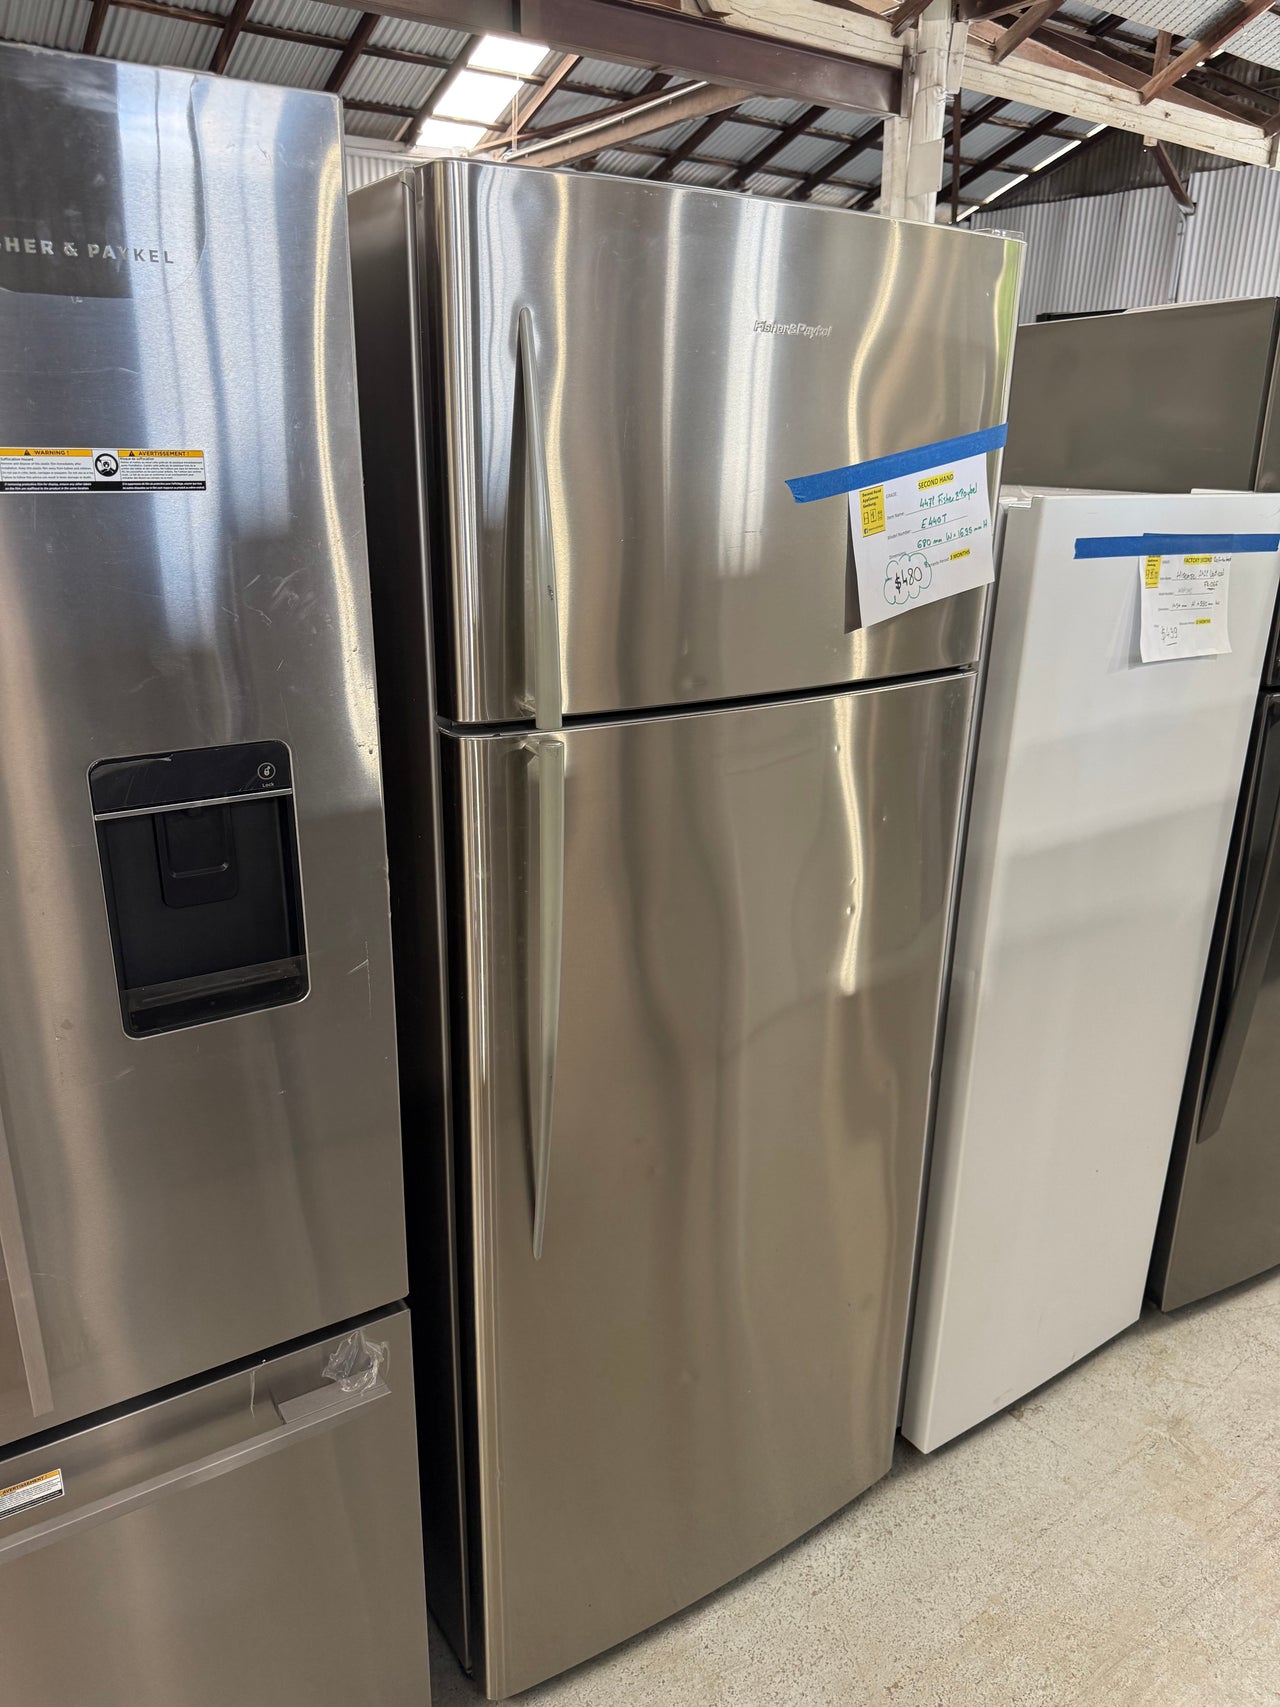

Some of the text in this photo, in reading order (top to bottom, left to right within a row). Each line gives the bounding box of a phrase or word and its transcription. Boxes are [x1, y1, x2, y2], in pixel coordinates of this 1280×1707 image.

[63, 241, 79, 257] &
[88, 243, 174, 264] PAYKEL
[918, 473, 954, 489] SECOND HAND
[916, 538, 931, 549] 680
[894, 566, 923, 595] $480
